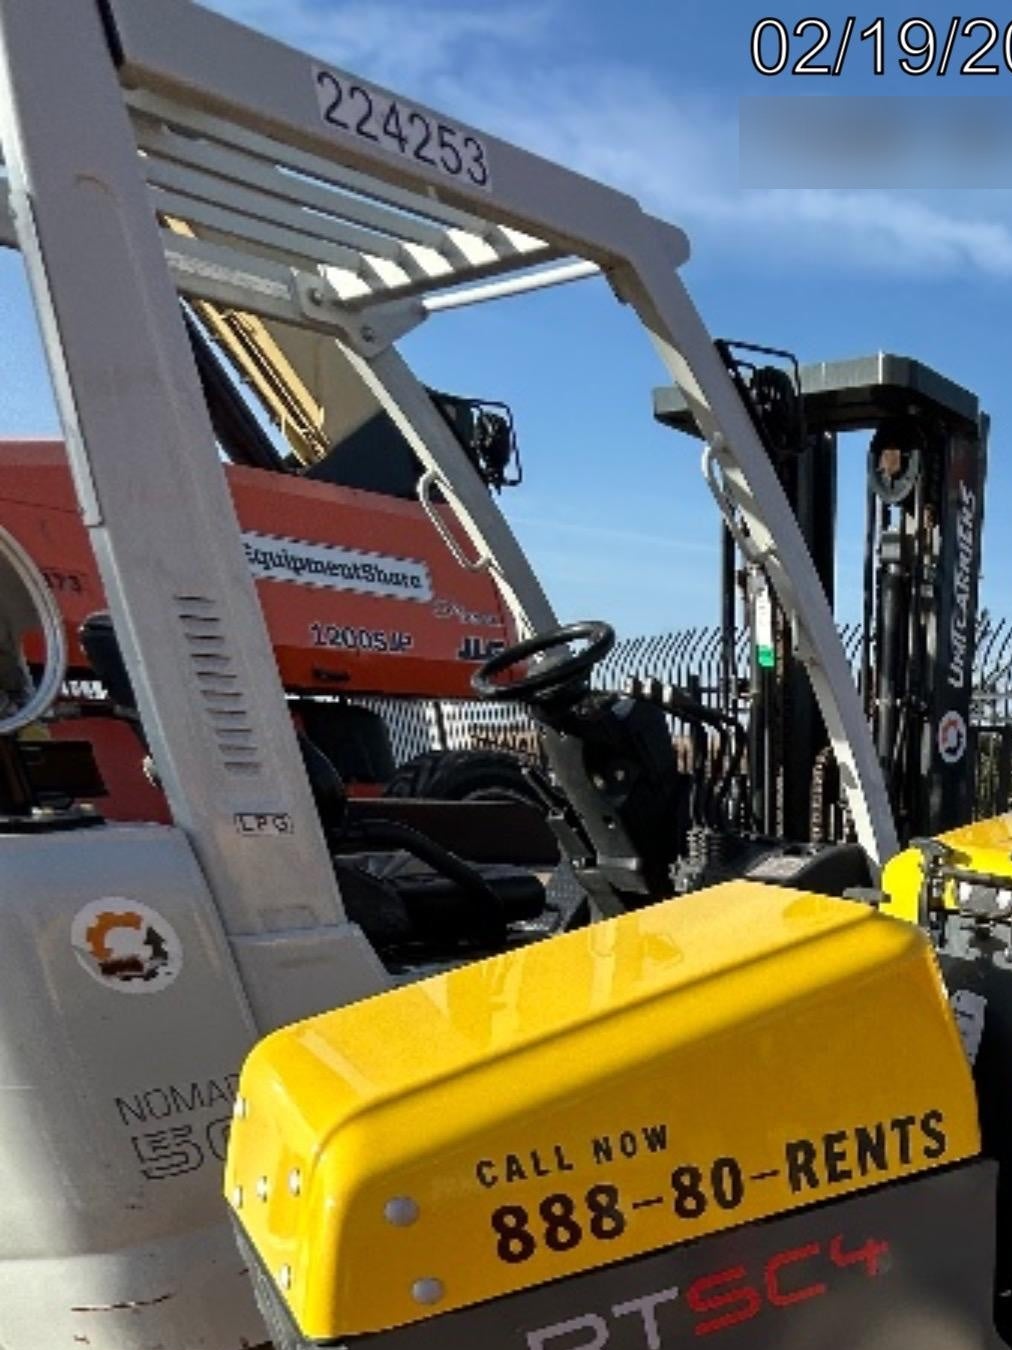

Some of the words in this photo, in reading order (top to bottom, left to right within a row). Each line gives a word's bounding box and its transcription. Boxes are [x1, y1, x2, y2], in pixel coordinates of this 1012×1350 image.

[317, 71, 488, 186] 224253
[239, 814, 288, 831] LPG
[476, 1146, 573, 1188] CALL
[591, 1124, 669, 1164] NOW
[491, 1109, 947, 1263] 888-80-RENTS
